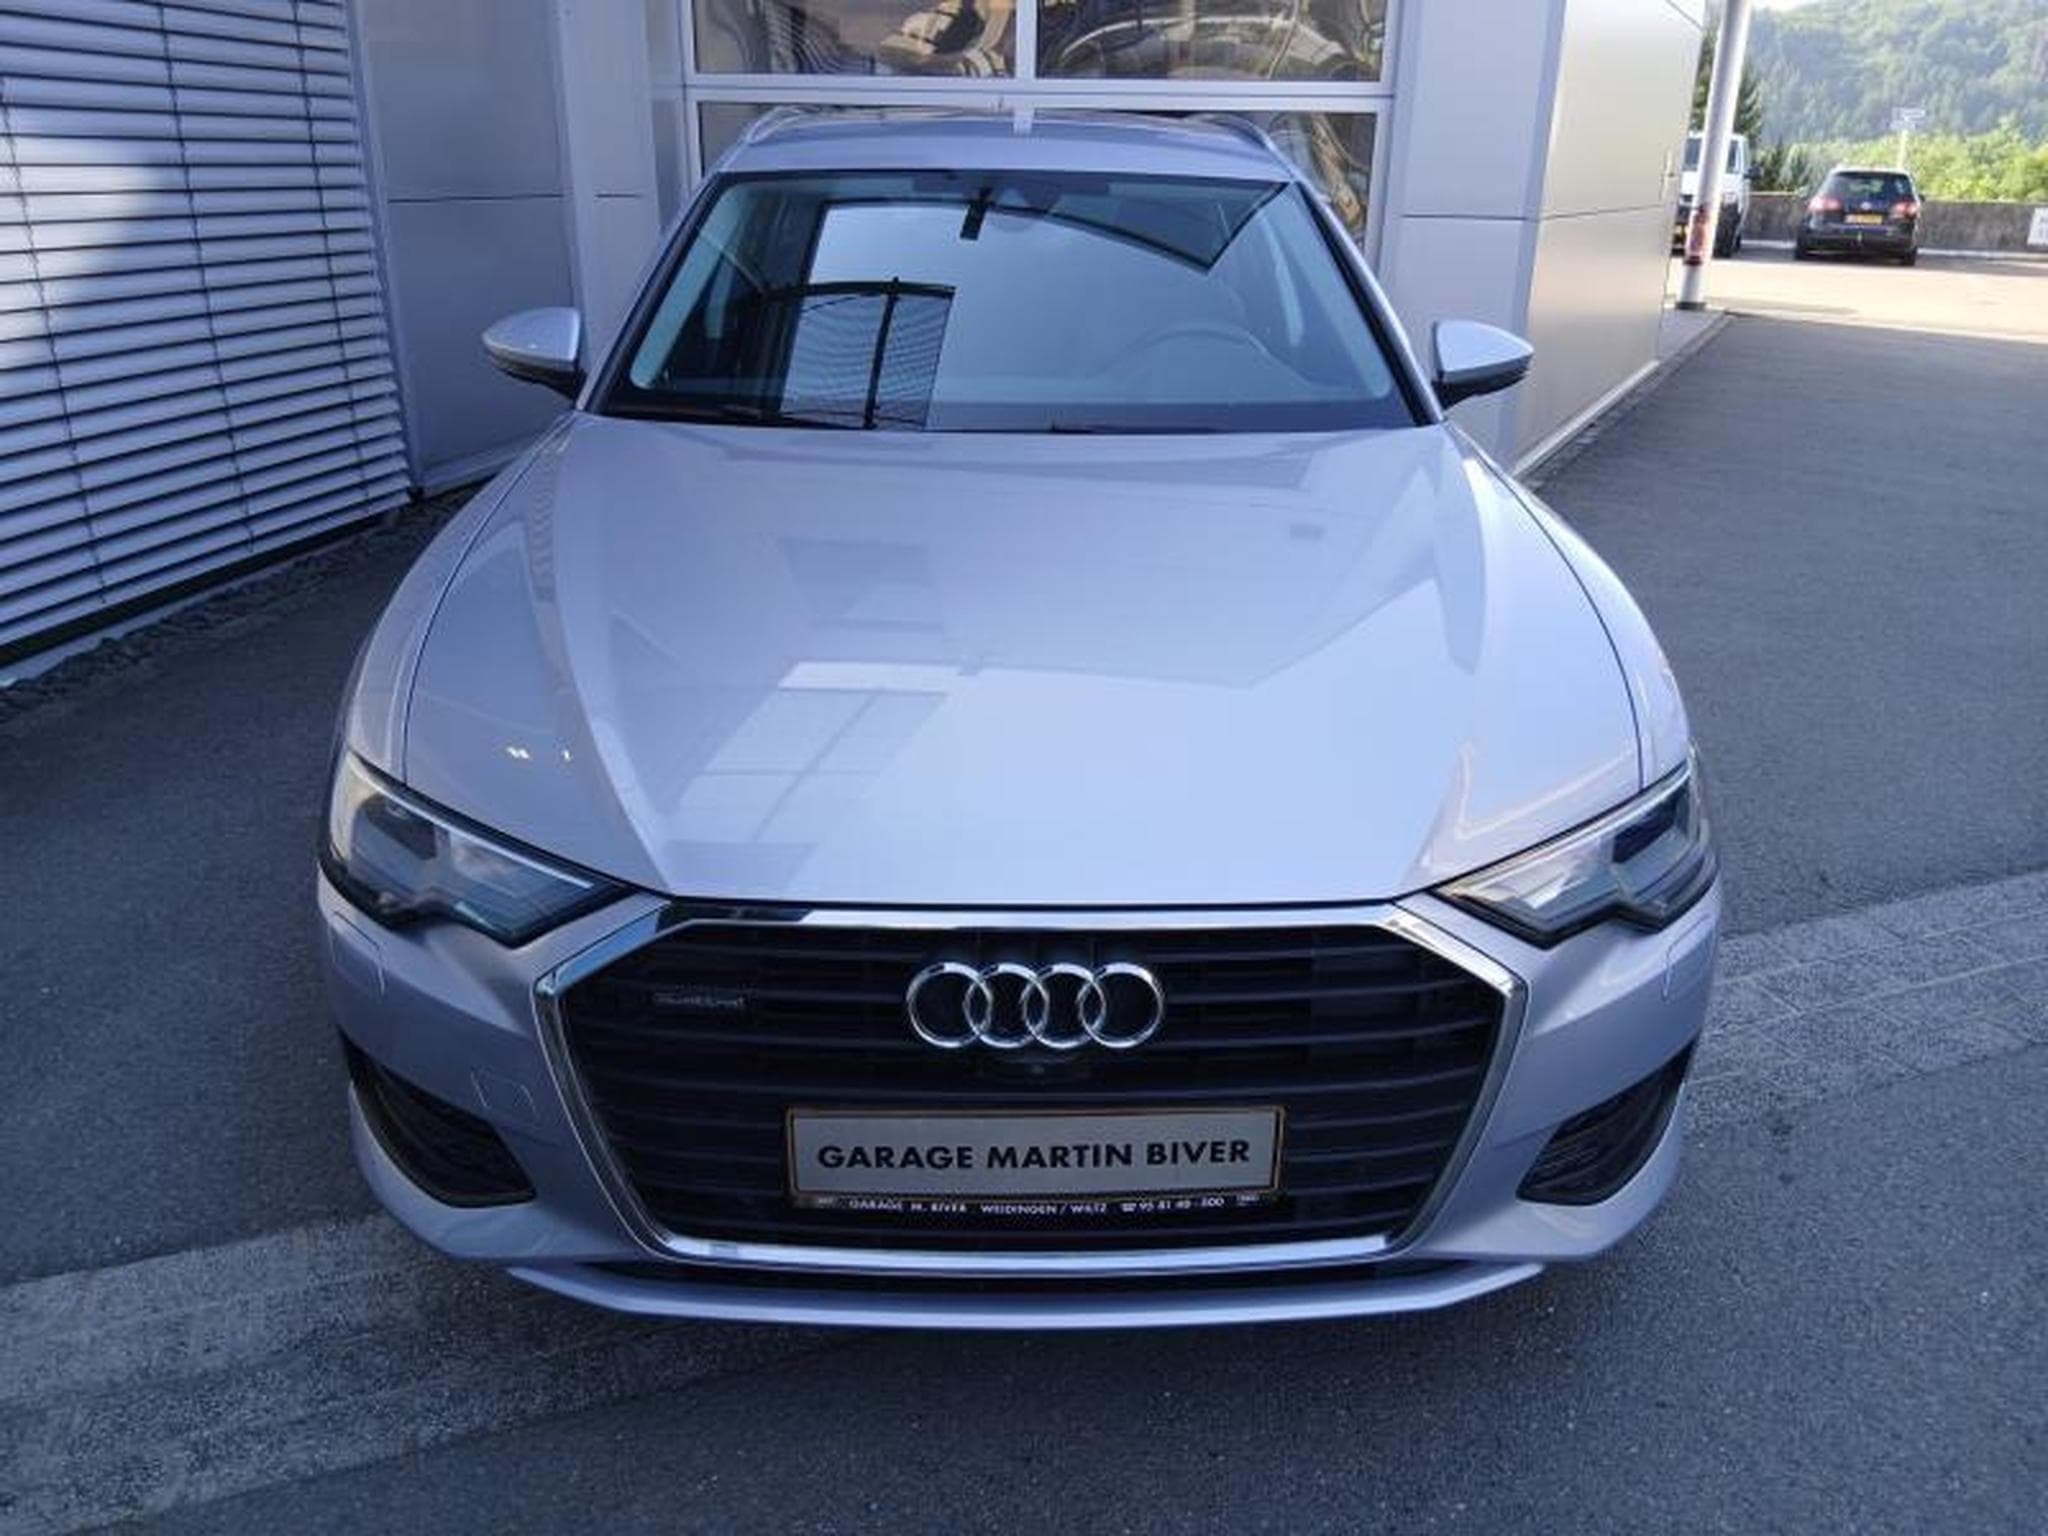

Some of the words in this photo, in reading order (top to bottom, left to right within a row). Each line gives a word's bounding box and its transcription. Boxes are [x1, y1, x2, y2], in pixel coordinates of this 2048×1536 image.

[817, 1145, 973, 1169] GARAGE
[987, 1143, 1133, 1168] MARTIN
[1147, 1139, 1250, 1165] BIVER
